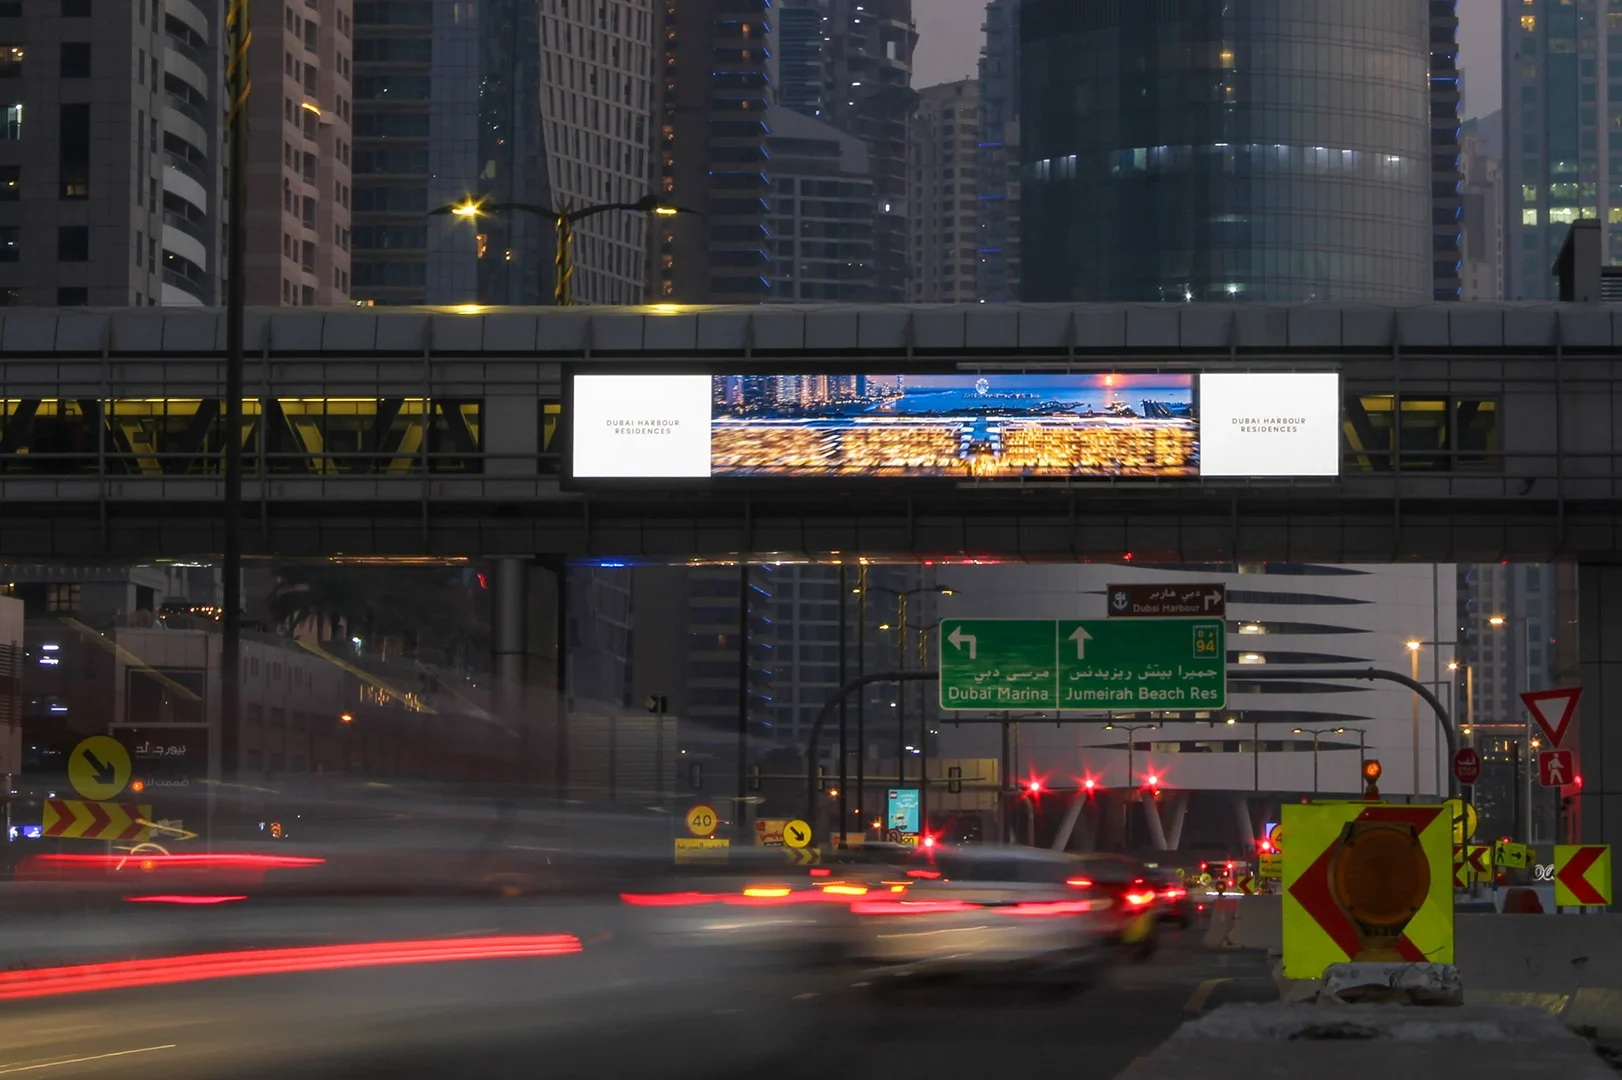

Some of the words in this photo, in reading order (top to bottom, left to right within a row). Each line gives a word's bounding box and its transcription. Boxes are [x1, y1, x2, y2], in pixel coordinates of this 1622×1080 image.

[1231, 417, 1260, 425] DUBAI
[1263, 417, 1306, 425] HARBOUR
[614, 427, 671, 435] RESIDENCES
[1240, 425, 1298, 433] RESIDENCES
[1181, 590, 1201, 602] دبي
[1132, 603, 1160, 613] Dubai
[1162, 603, 1200, 613] Harbour
[1196, 639, 1215, 653] 94
[974, 668, 1001, 684] دبي
[1069, 665, 1132, 681] ريزيدنس
[1137, 663, 1173, 681] بيتش
[1178, 664, 1218, 680] جميرا
[948, 686, 993, 701] Dubai
[997, 686, 1050, 701] Marina
[1066, 686, 1133, 701] Jumeirah
[1138, 686, 1185, 700] Beach
[1190, 686, 1218, 700] Res
[1457, 766, 1478, 777] STOP
[692, 814, 712, 827] 40
